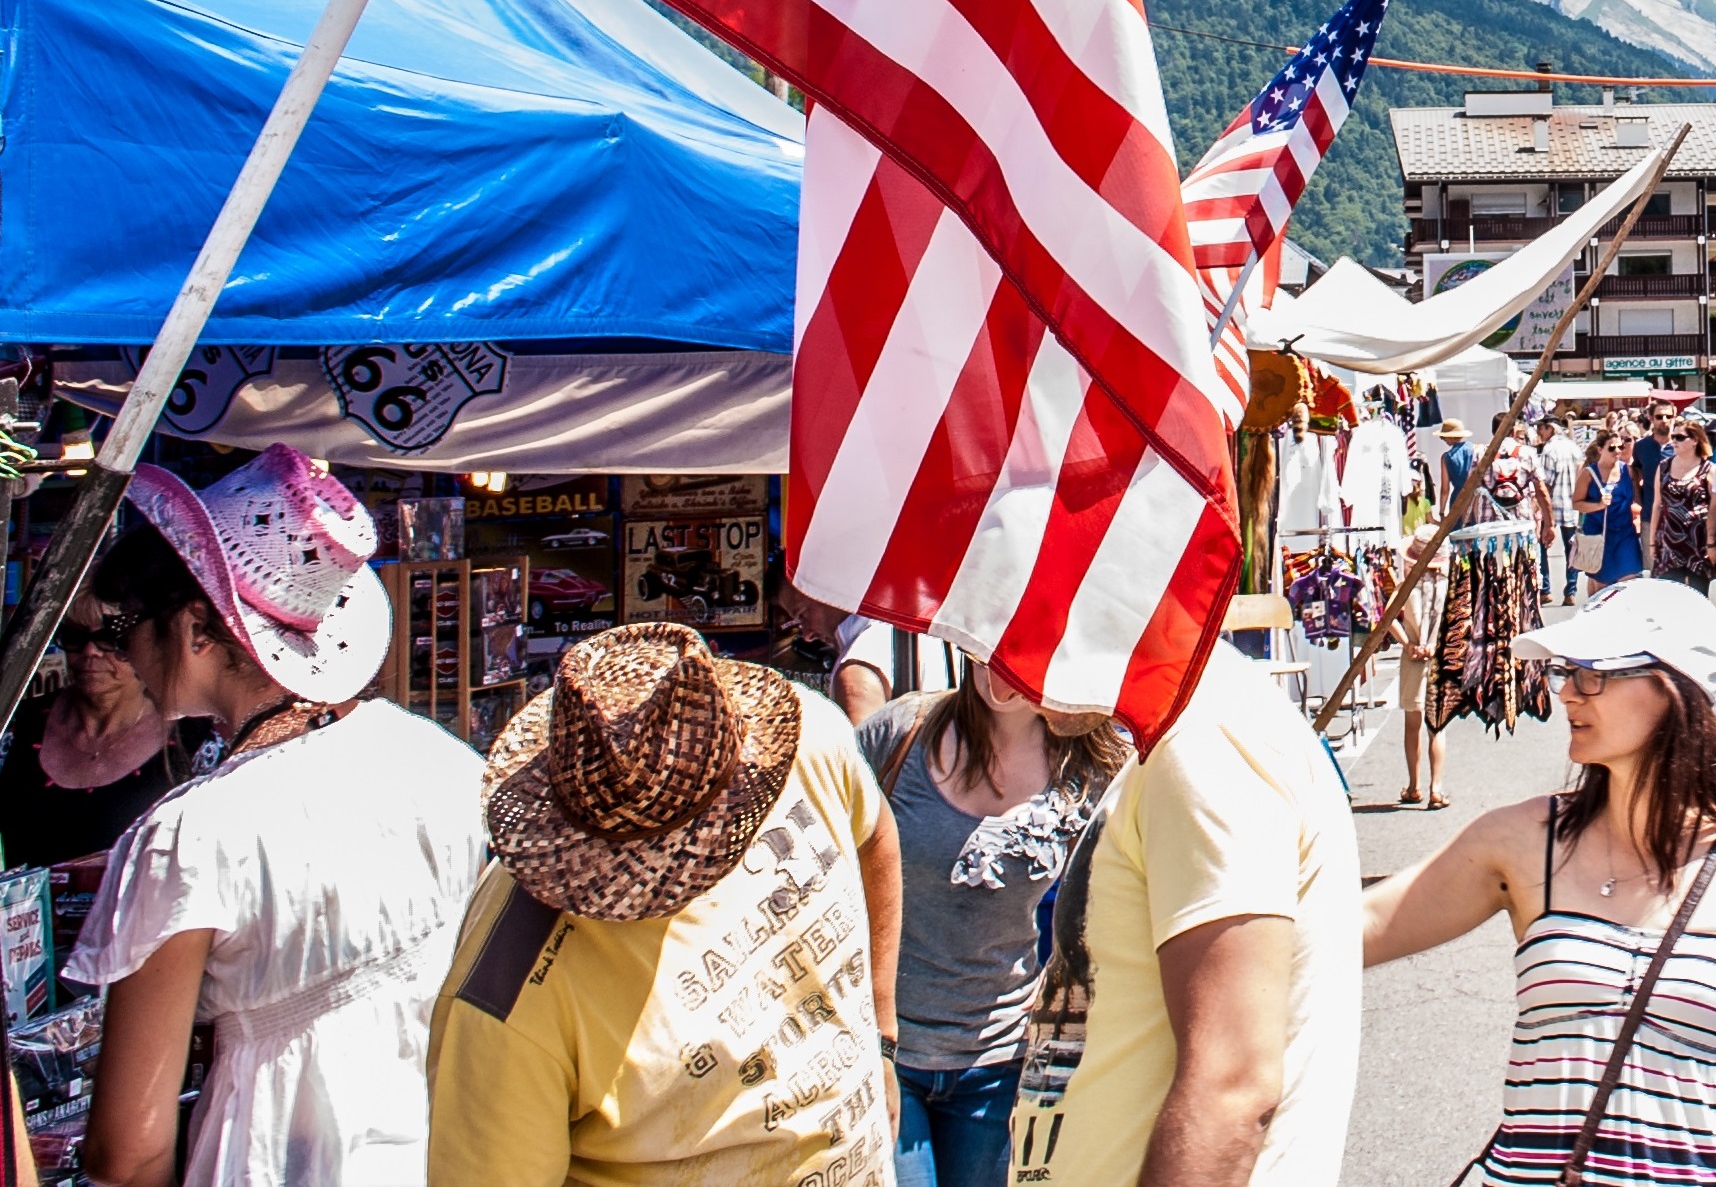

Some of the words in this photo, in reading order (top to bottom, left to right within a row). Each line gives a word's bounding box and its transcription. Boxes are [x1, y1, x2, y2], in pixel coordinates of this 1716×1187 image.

[1605, 358, 1646, 369] agence
[1649, 358, 1662, 368] du
[1665, 356, 1694, 369] giffre
[343, 346, 428, 432] 66
[465, 492, 604, 519] BASEBALL
[628, 524, 692, 554] LAST
[695, 521, 761, 552] STOP
[554, 621, 568, 633] To
[572, 619, 613, 633] Reality
[717, 900, 860, 1039] WATER
